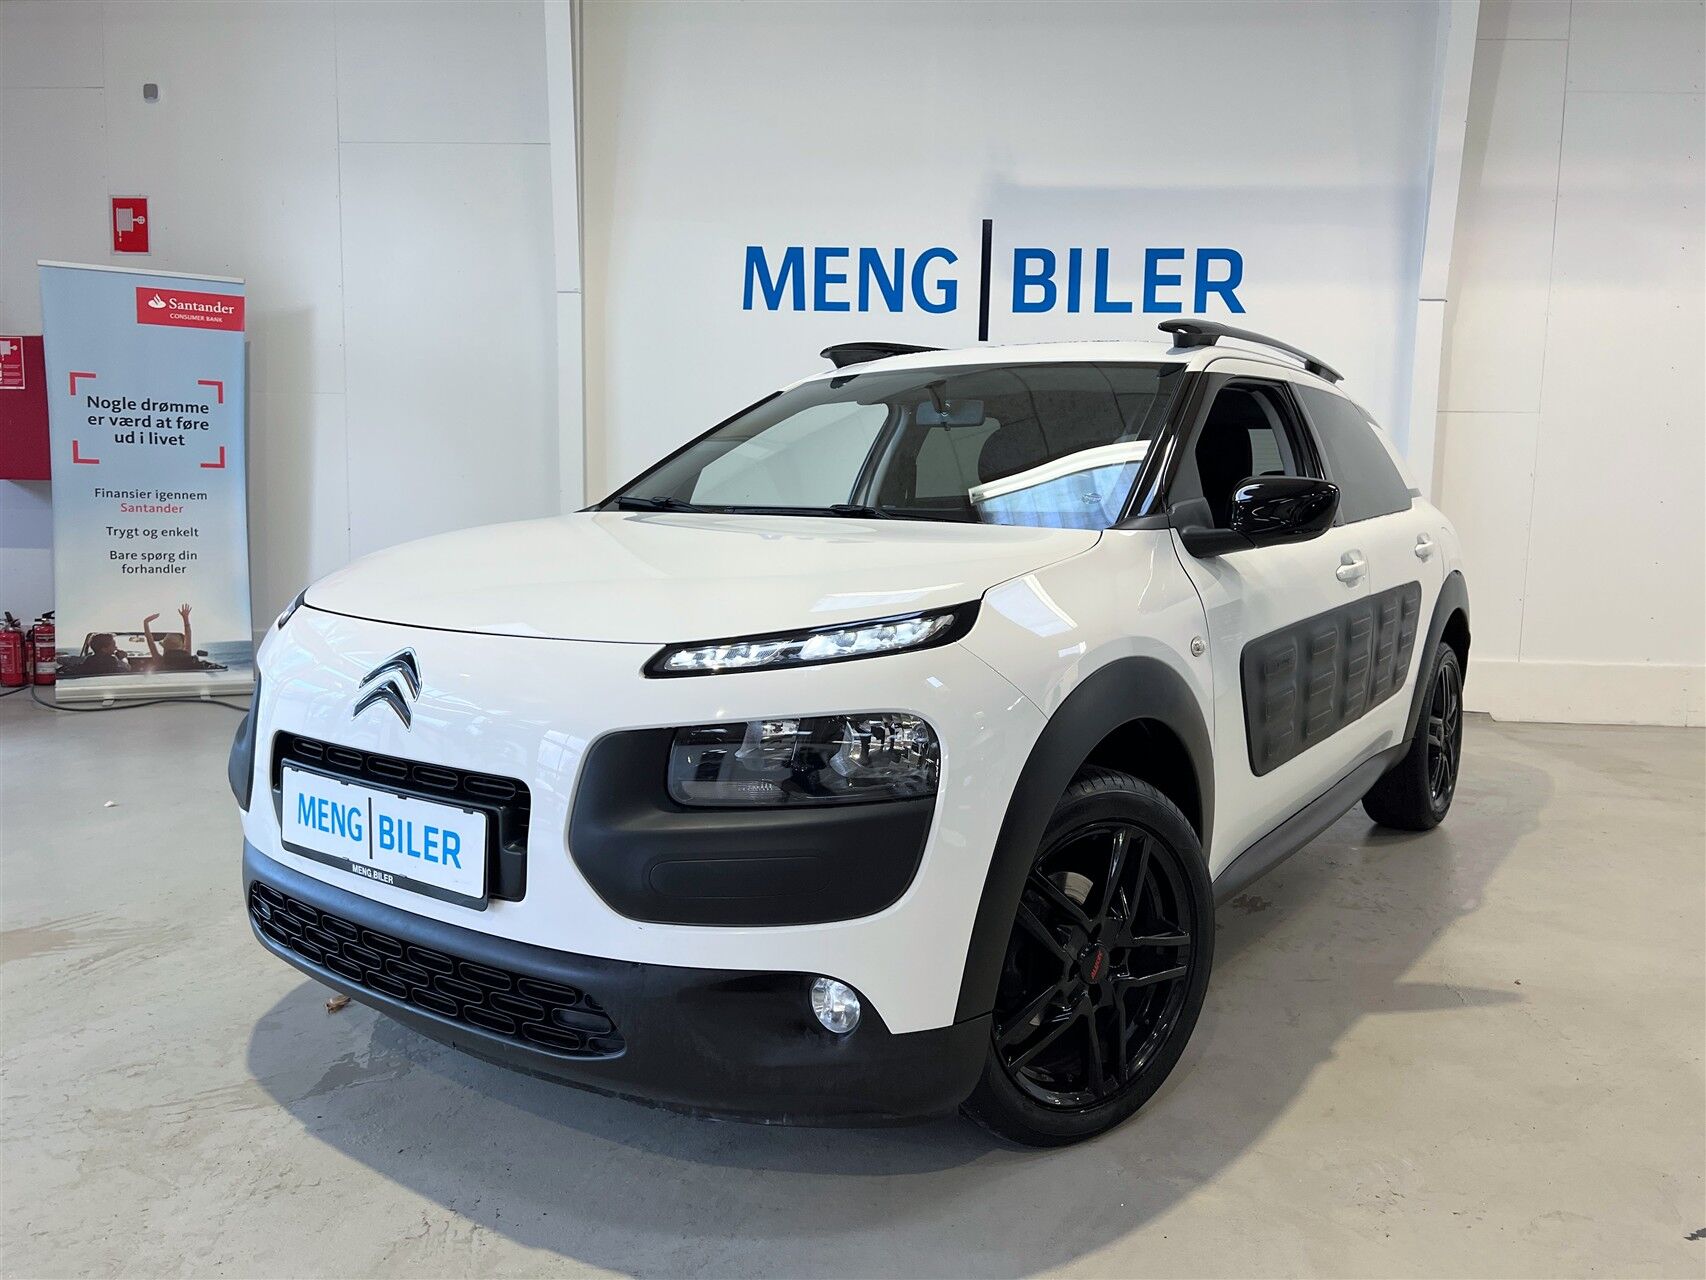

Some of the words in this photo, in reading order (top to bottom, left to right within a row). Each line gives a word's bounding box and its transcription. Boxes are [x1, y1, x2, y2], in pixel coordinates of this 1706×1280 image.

[742, 245, 959, 314] MENG
[1012, 246, 1247, 314] BILER
[168, 297, 235, 314] Santander
[169, 312, 205, 321] CONSUMER
[206, 315, 223, 323] BANK
[87, 395, 137, 413] Nogle
[141, 397, 210, 414] drømme
[87, 415, 105, 426] er
[109, 414, 152, 428] værd
[156, 417, 173, 429] at
[176, 416, 210, 431] føre
[114, 430, 135, 444] ud
[140, 431, 144, 444] i
[149, 431, 186, 446] livet
[94, 488, 152, 499] Finansier
[155, 489, 208, 502] igennem
[120, 502, 184, 513] Santander
[105, 526, 139, 539] Trygt
[142, 528, 158, 539] og
[161, 527, 200, 537] enkelt
[109, 550, 138, 560] Bare
[141, 551, 176, 563] spørg
[178, 550, 198, 560] din
[121, 563, 187, 574] forhandler
[297, 792, 363, 842] MENG
[378, 814, 463, 870] BILER
[352, 863, 372, 878] MENG
[373, 869, 394, 885] BILER
